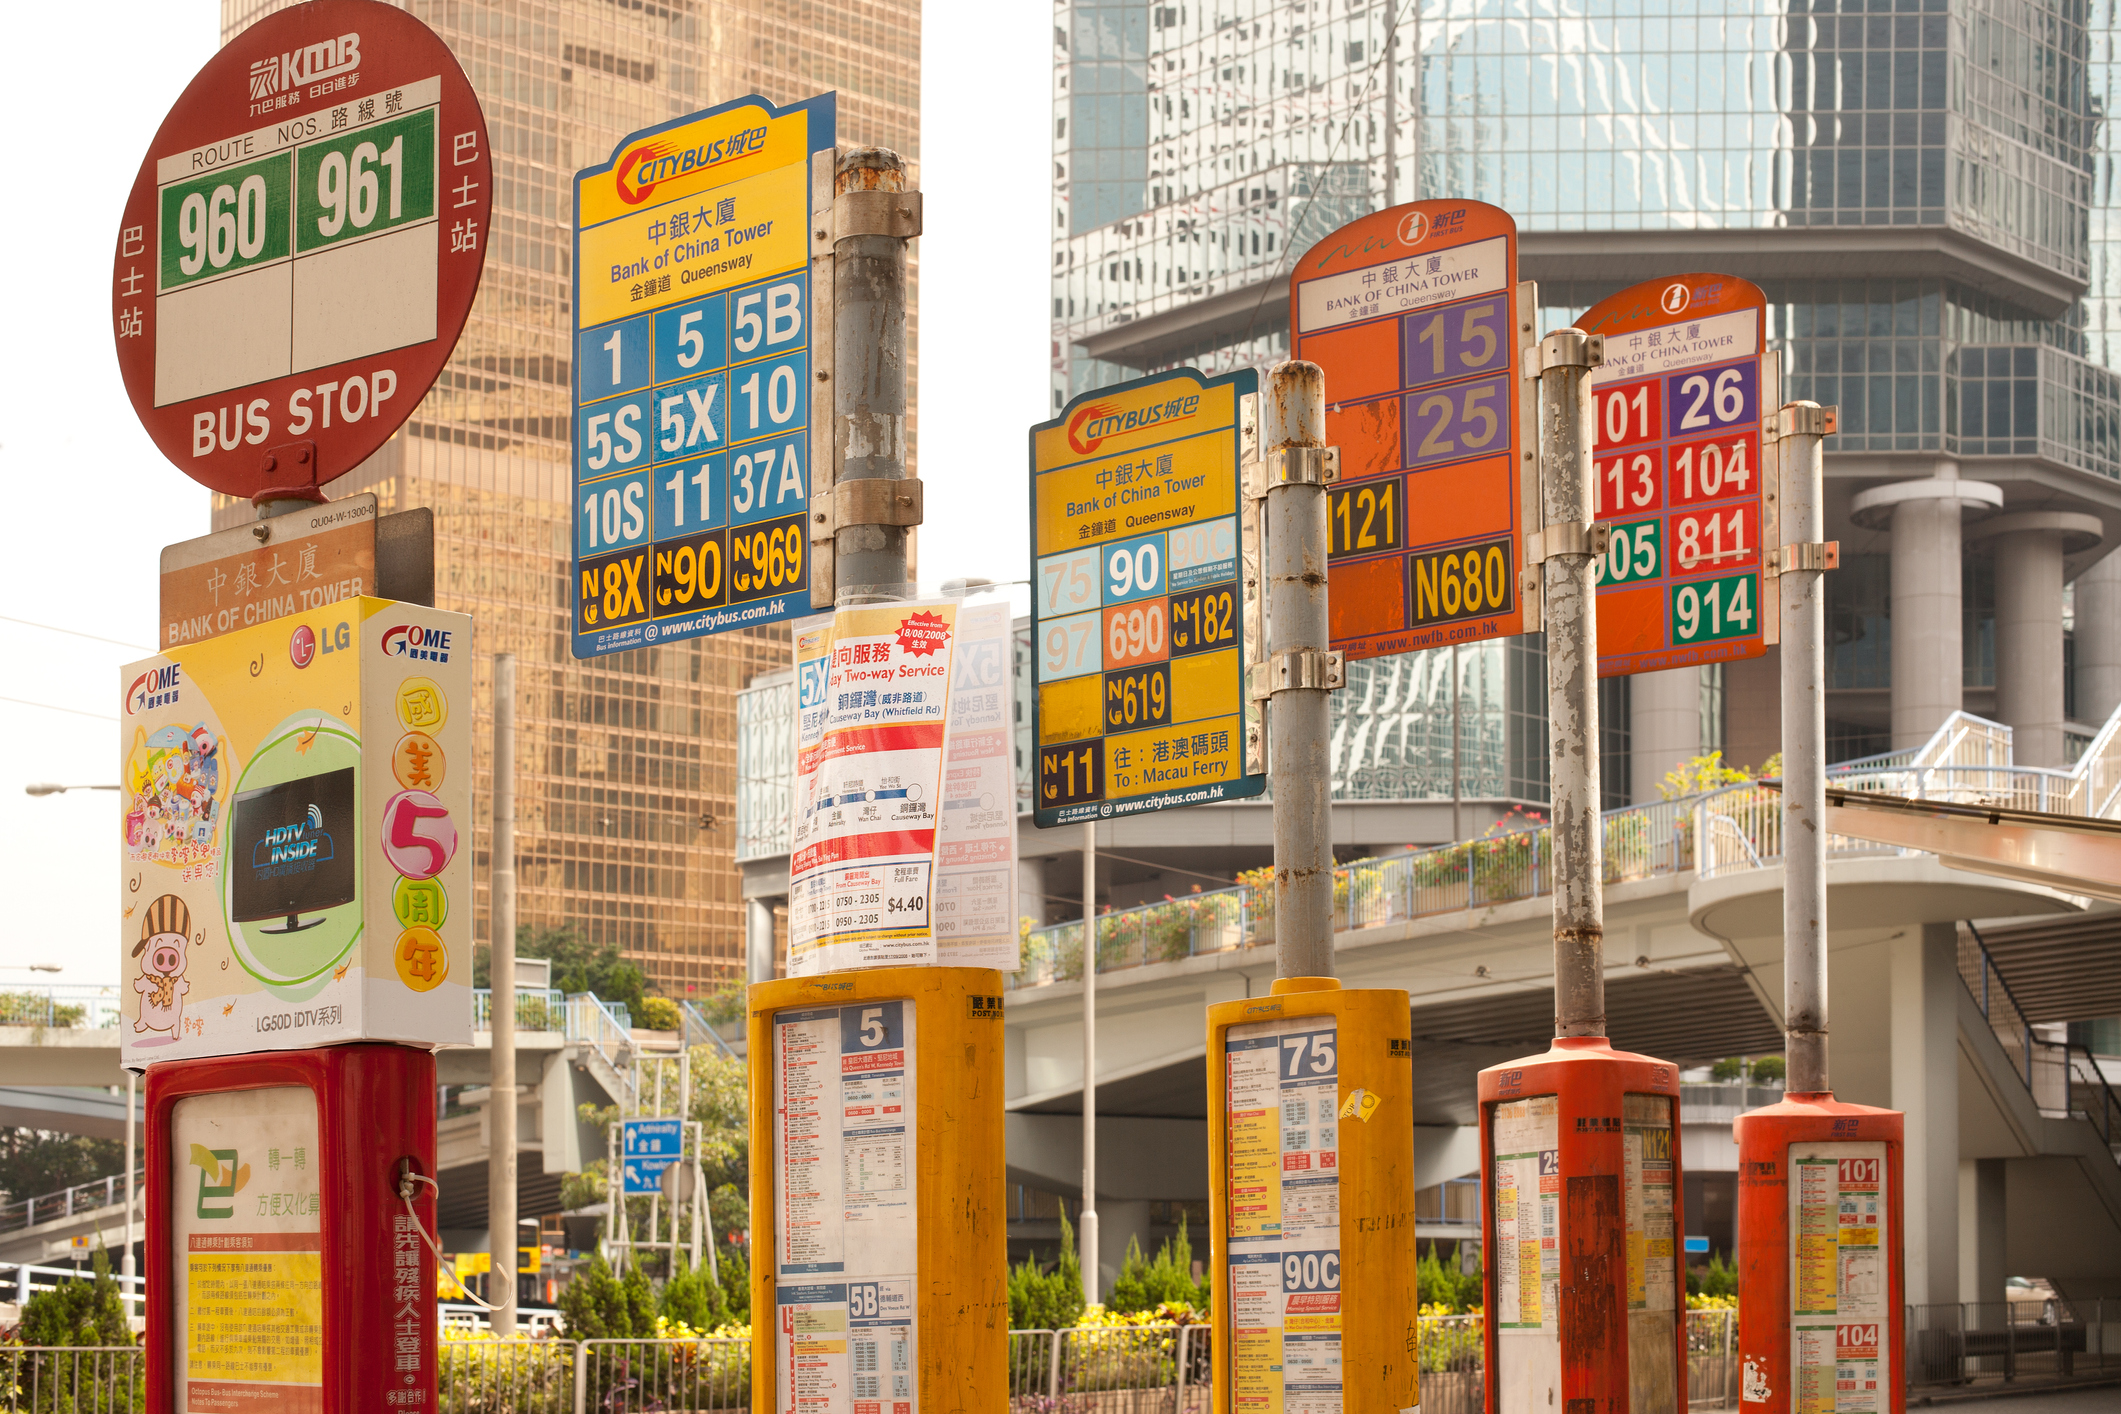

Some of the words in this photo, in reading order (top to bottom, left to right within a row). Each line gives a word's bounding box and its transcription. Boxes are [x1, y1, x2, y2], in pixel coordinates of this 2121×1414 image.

[281, 32, 361, 90] KMB
[249, 91, 300, 117] 九巴服務
[310, 72, 360, 99] 日日進步
[192, 137, 254, 170] ROUTE
[277, 117, 322, 145] NOS.
[637, 139, 725, 185] CITYBUS
[725, 126, 768, 156] 城巴
[317, 135, 403, 238] 961
[451, 131, 479, 253] 巴士站
[179, 175, 266, 276] 960
[647, 197, 736, 246] 中銀大廈
[1430, 228, 1449, 239] FIRST
[1450, 225, 1463, 235] BUS
[1431, 209, 1466, 230] 新巴
[611, 257, 649, 283] Bank
[654, 250, 669, 269] of
[674, 235, 720, 263] China
[725, 219, 773, 247] Tower
[1362, 255, 1442, 289] 中銀大廈
[120, 225, 144, 338] 巴士站
[630, 275, 671, 302] 金鐘道
[681, 253, 753, 285] Queensway
[1326, 294, 1361, 311] BANK
[1365, 289, 1382, 302] OF
[1386, 279, 1429, 298] CHINA
[1432, 267, 1479, 286] TOWER
[1692, 283, 1723, 300] 新巴
[734, 282, 801, 353] 5B
[1349, 304, 1379, 319] 金鐘道
[1400, 289, 1457, 308] Queensway
[604, 329, 622, 386] 1
[676, 310, 704, 368] 5
[1419, 304, 1497, 375] 15
[1629, 323, 1701, 351] 中銀大廈
[1632, 351, 1647, 363] OF
[1651, 343, 1688, 359] CHINA
[1691, 335, 1733, 350] TOWER
[1618, 364, 1644, 376] 金鐘道
[1663, 353, 1714, 368] Queensway
[192, 398, 270, 457] BUS
[287, 369, 397, 435] STOP
[660, 383, 719, 453] 5X
[740, 364, 796, 430] 10
[1086, 404, 1164, 439] CITYBUS
[1164, 395, 1199, 419] 城巴
[1592, 386, 1648, 446] 101
[1680, 368, 1744, 430] 26
[587, 404, 642, 470] 5S
[1417, 385, 1498, 458] 25
[733, 444, 804, 513] 37A
[1096, 453, 1174, 490] 中銀大廈
[1593, 454, 1654, 514] 113
[1676, 439, 1750, 499] 104
[310, 504, 374, 529] QU04-W-1300-0
[584, 482, 644, 548] 10S
[666, 464, 710, 527] 11
[1066, 497, 1100, 517] Bank
[1103, 492, 1117, 509] of
[1121, 484, 1160, 505] China
[1164, 473, 1206, 493] Tower
[1078, 518, 1117, 540] 金鐘道
[1125, 503, 1195, 528] Queensway
[1678, 509, 1744, 570] 811
[1172, 521, 1233, 569] 90C
[207, 543, 323, 607] 中銀大廈
[1044, 557, 1092, 610] 75
[1109, 543, 1159, 597] 90
[1416, 546, 1505, 620] N680
[169, 613, 212, 644] BANK
[217, 607, 239, 631] OF
[243, 594, 296, 624] CHINA
[300, 577, 363, 611] TOWER
[661, 599, 785, 636] www.citybus.com.hk
[908, 620, 929, 628] Effective
[1676, 577, 1752, 640] 914
[322, 621, 350, 654] LG
[596, 643, 607, 651] Bus
[607, 637, 642, 650] information
[900, 628, 946, 641] 18/08/2008
[912, 640, 927, 649] 生效
[1046, 620, 1094, 672] 97
[1109, 605, 1164, 660] 690
[1376, 621, 1498, 652] www.nwfb.com.hk
[845, 667, 895, 683] Two-way
[899, 664, 945, 678] Service
[1639, 643, 1747, 669] www.nwfb.com.hk
[801, 659, 830, 706] 5X
[830, 710, 861, 724] Causeway
[864, 709, 880, 719] Bay
[882, 707, 923, 719] (Whitfield
[925, 706, 940, 715] Rd)
[1114, 772, 1130, 788] To
[1143, 764, 1188, 784] Macau
[1193, 758, 1229, 777] Ferry
[1068, 813, 1098, 822] information
[1115, 786, 1224, 813] www.citybus.com.hk
[265, 822, 305, 847] HDTV
[271, 839, 318, 865] INSIDE
[847, 880, 870, 888] Causeway
[871, 878, 881, 886] Bay
[888, 896, 923, 914] $4.40
[257, 1013, 291, 1033] LG50D
[294, 1004, 342, 1028] iDTV系列
[860, 1008, 884, 1047] 5
[1283, 1034, 1335, 1076] 75
[1832, 1119, 1859, 1131] 新巴
[1840, 1159, 1877, 1182] 101
[1284, 1253, 1340, 1290] 90C
[851, 1285, 878, 1316] 5B
[1838, 1325, 1877, 1346] 104
